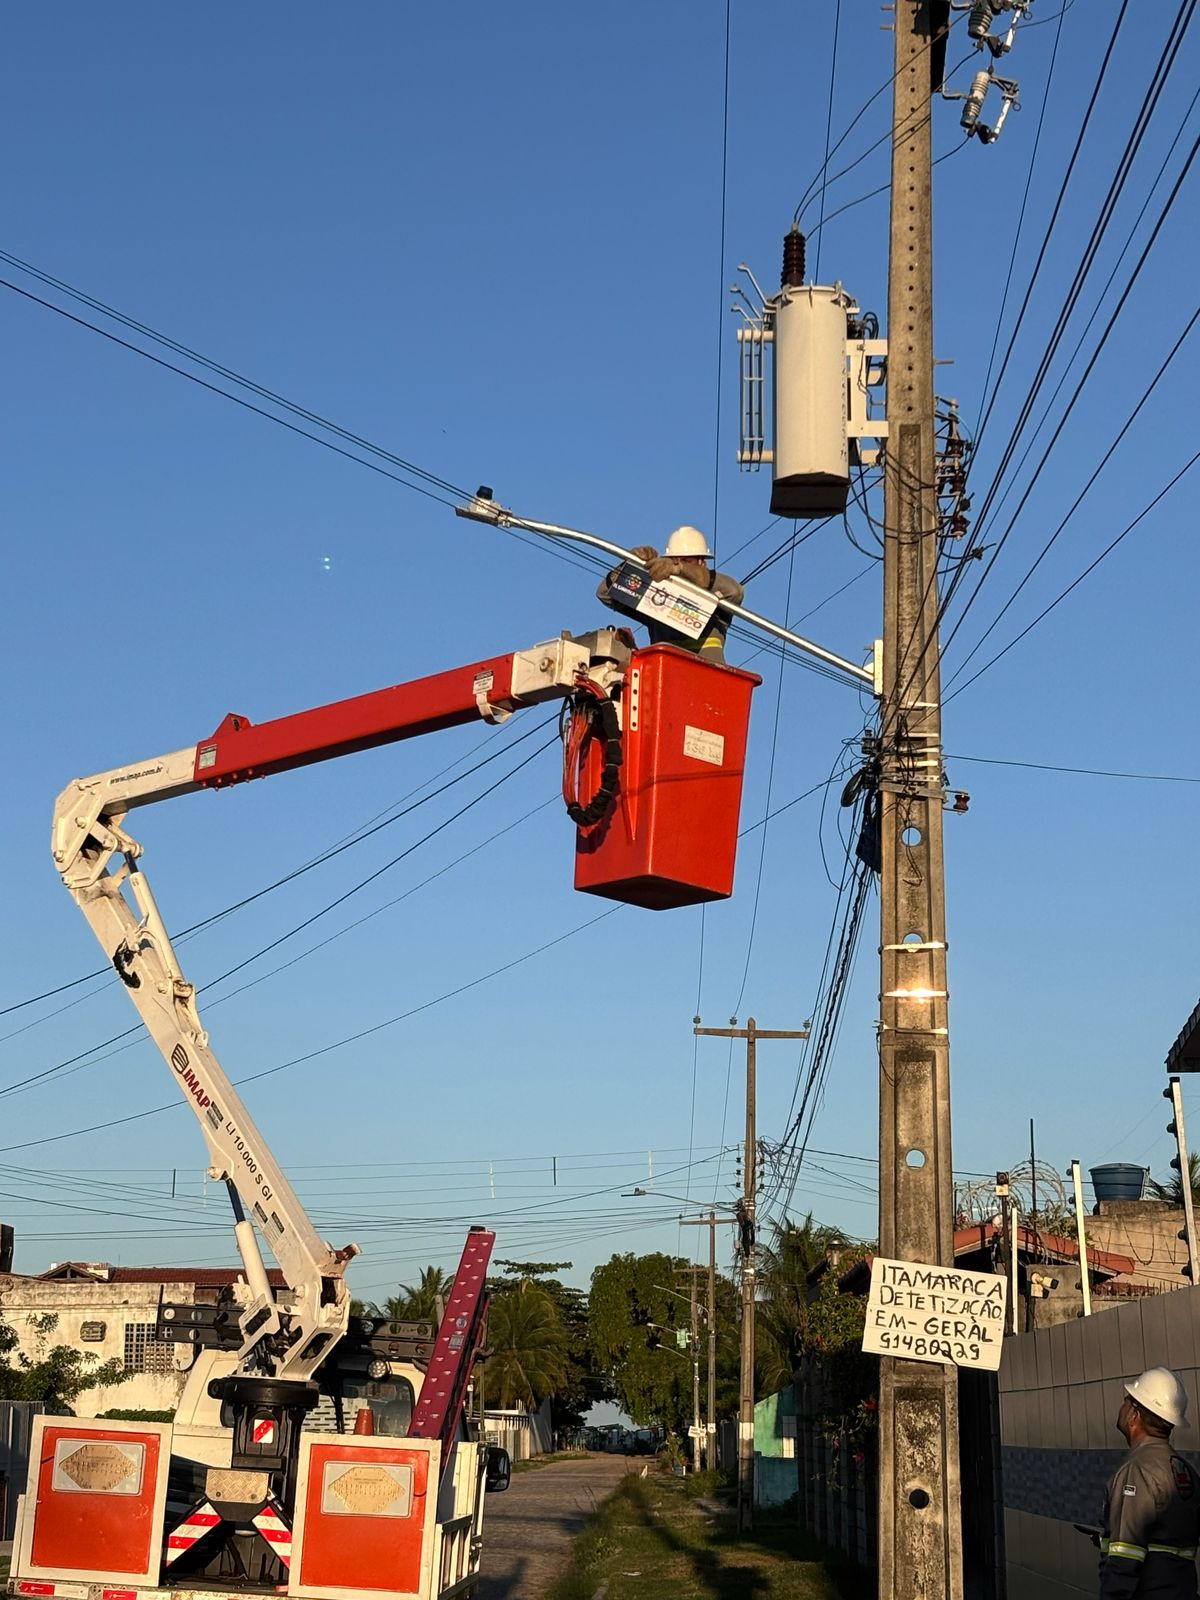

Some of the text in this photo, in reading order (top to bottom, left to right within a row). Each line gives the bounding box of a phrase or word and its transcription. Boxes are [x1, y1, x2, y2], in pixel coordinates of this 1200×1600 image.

[183, 1068, 211, 1108] IMAP
[225, 1121, 273, 1201] LI 10.000 S GI
[882, 1264, 1003, 1300] ITAMARACA
[879, 1332, 980, 1361] 91480229
